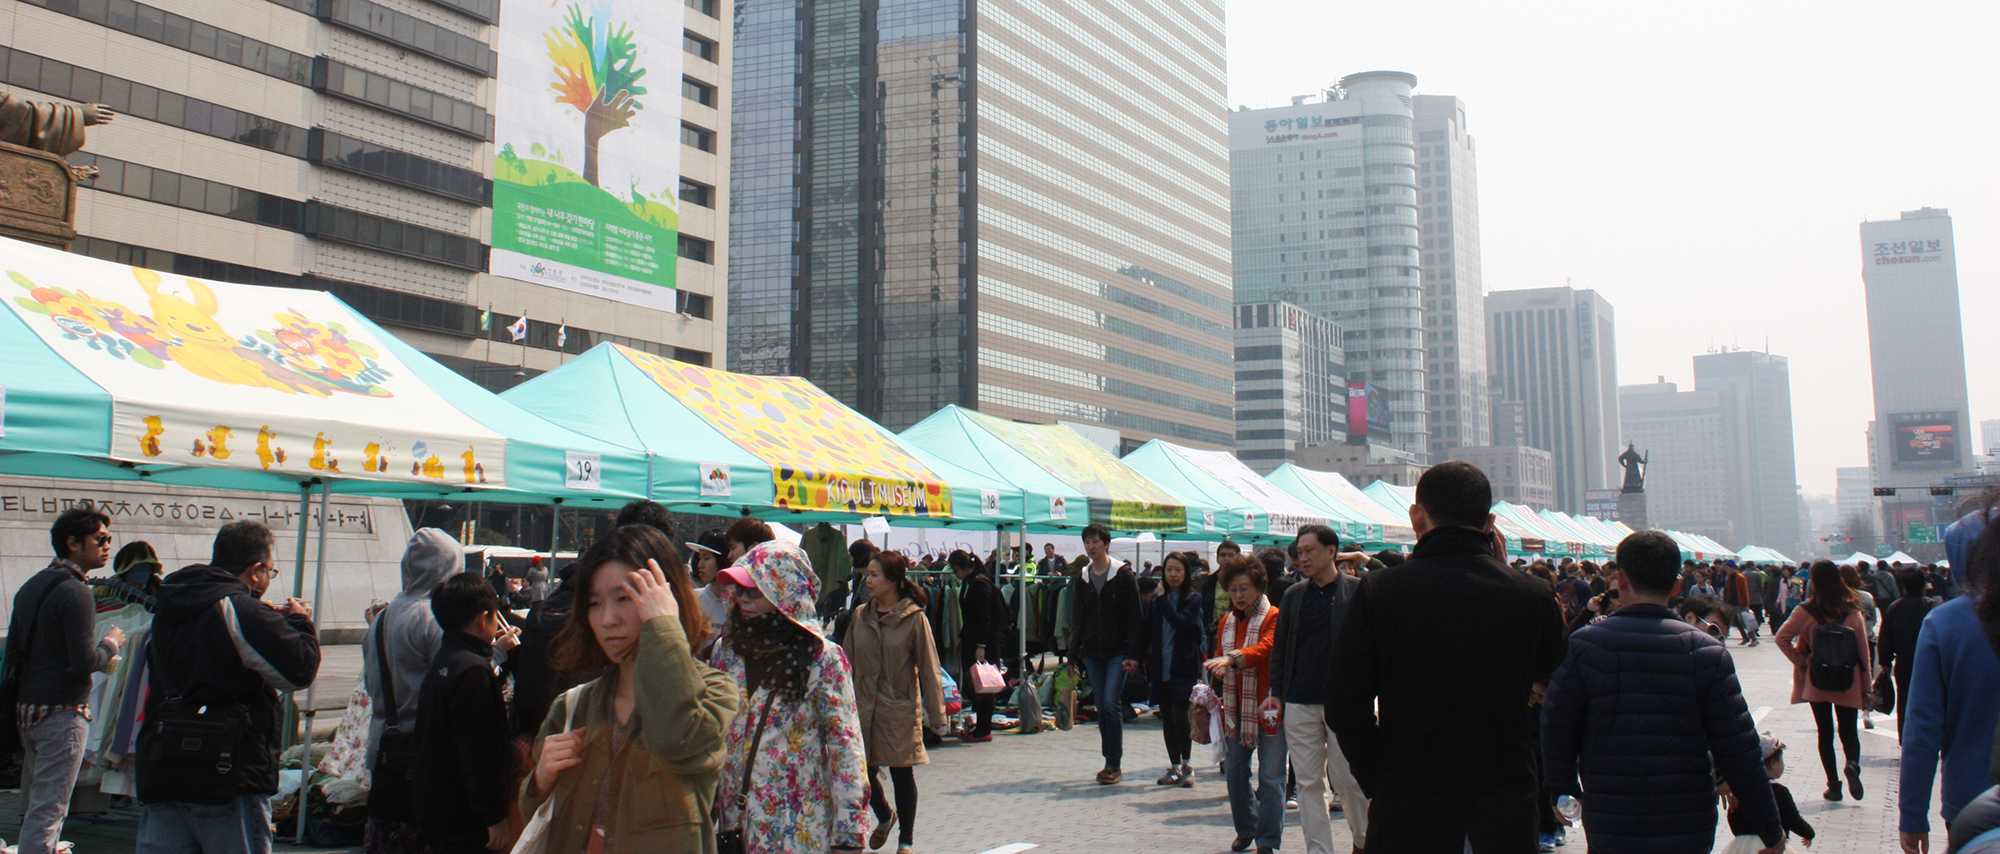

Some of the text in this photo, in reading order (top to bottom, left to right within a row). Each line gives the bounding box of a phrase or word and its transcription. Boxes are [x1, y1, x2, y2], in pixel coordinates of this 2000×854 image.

[1264, 115, 1324, 132] 동아일보
[1874, 239, 1943, 256] 조선일보
[1875, 255, 1941, 265] chosun.com
[577, 460, 592, 482] 19
[826, 478, 927, 508] KIDULT MUSEUM
[987, 494, 996, 510] 18
